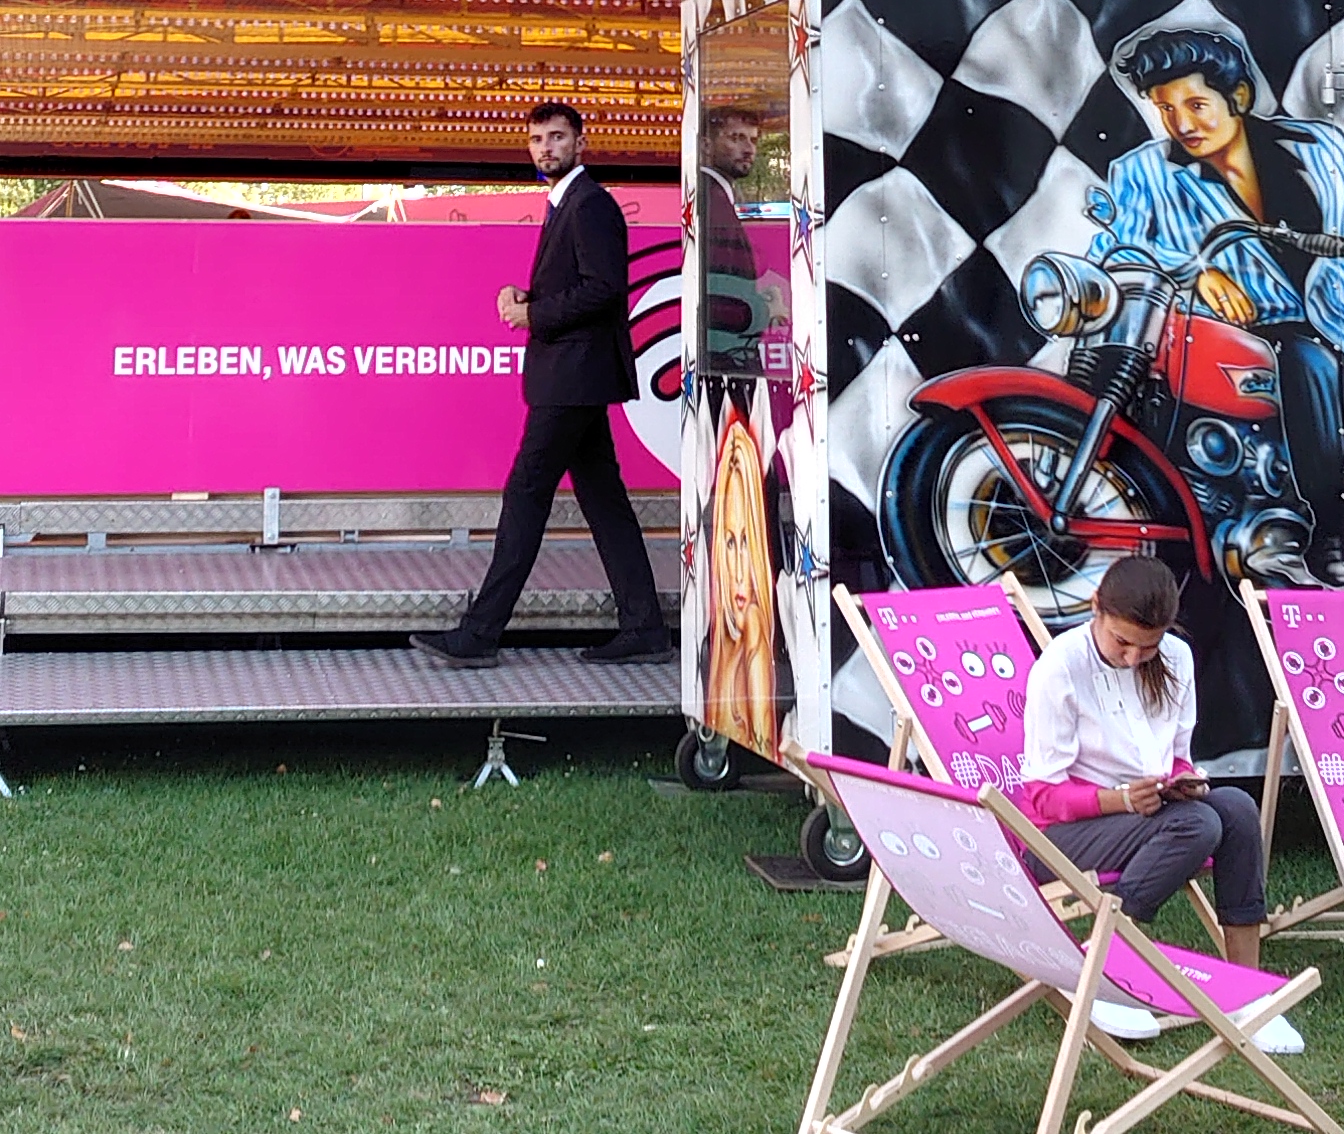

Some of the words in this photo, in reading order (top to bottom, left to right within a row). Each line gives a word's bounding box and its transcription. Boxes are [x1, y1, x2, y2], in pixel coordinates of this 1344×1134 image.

[114, 346, 271, 380] ERLEBEN,
[277, 345, 346, 375] WAS
[950, 751, 1025, 795] #DA
